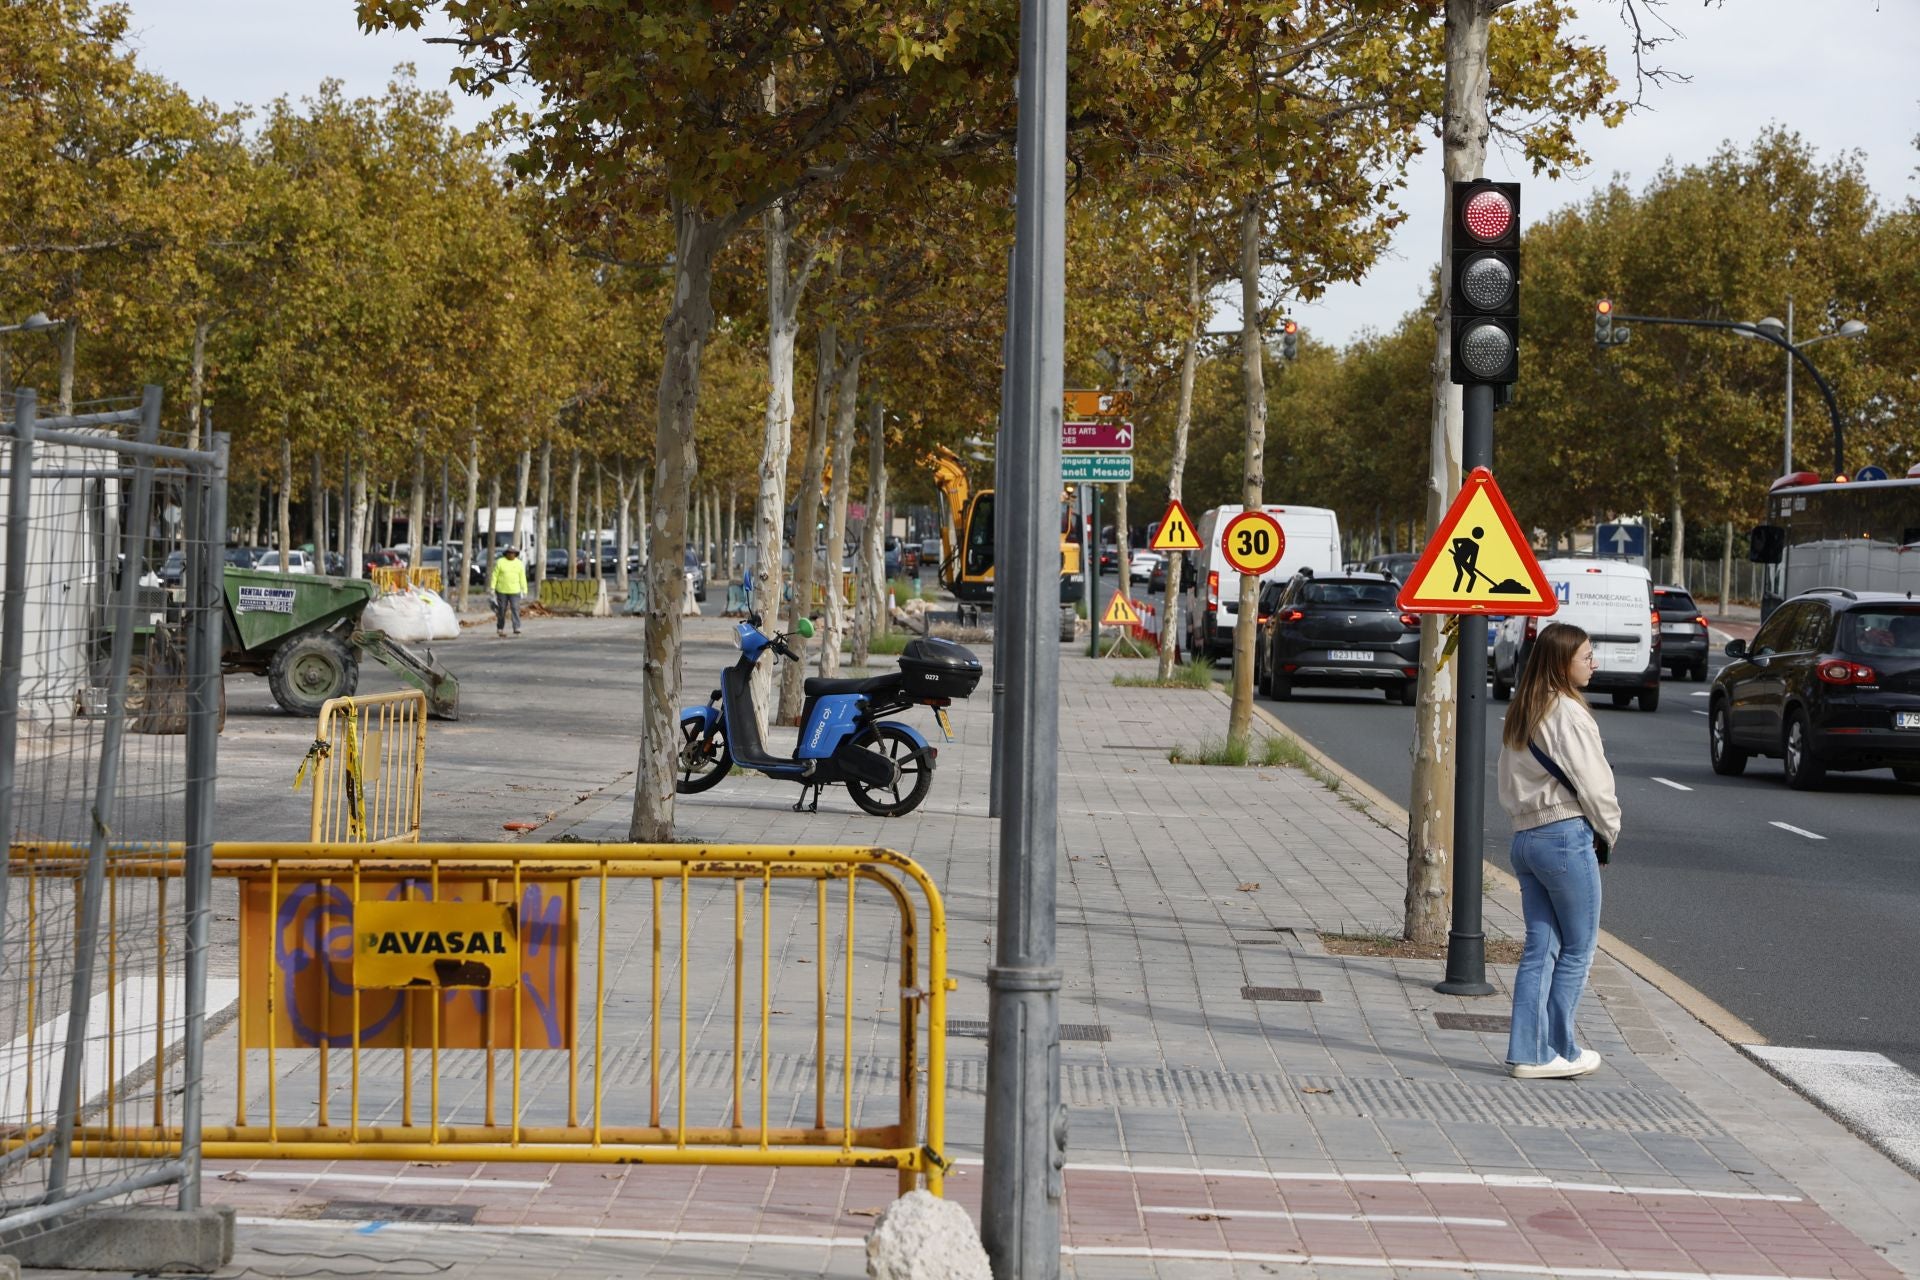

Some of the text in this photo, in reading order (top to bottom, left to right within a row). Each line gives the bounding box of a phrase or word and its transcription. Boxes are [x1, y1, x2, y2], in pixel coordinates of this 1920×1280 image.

[1063, 427, 1096, 435] LES ARTS
[1062, 468, 1131, 476] anell Mesado
[1237, 529, 1269, 556] 30
[240, 588, 262, 596] RENTAL
[264, 589, 294, 598] COMPANY
[925, 673, 939, 681] 0272
[811, 721, 826, 749] cooltra
[360, 931, 506, 954] PAVASAL
